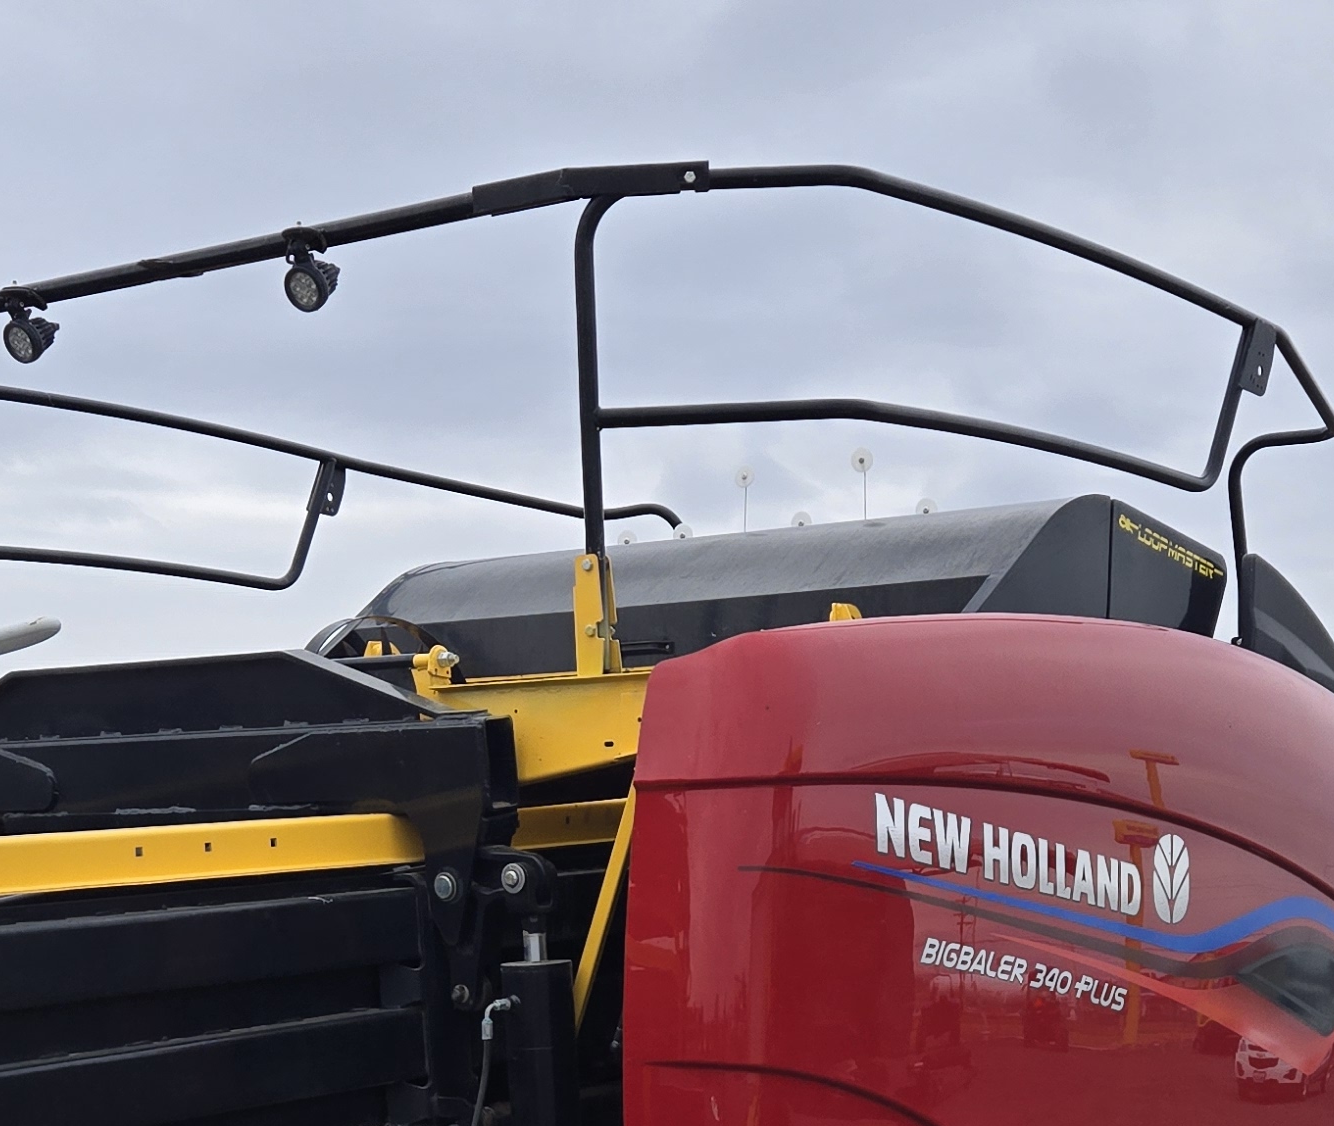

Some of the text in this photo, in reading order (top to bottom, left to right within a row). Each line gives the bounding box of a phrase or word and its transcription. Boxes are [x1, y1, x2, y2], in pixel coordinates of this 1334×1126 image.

[874, 792, 1142, 917] NEW HOLLAND
[920, 937, 1028, 984] BIGBALER
[1029, 963, 1072, 996] 340
